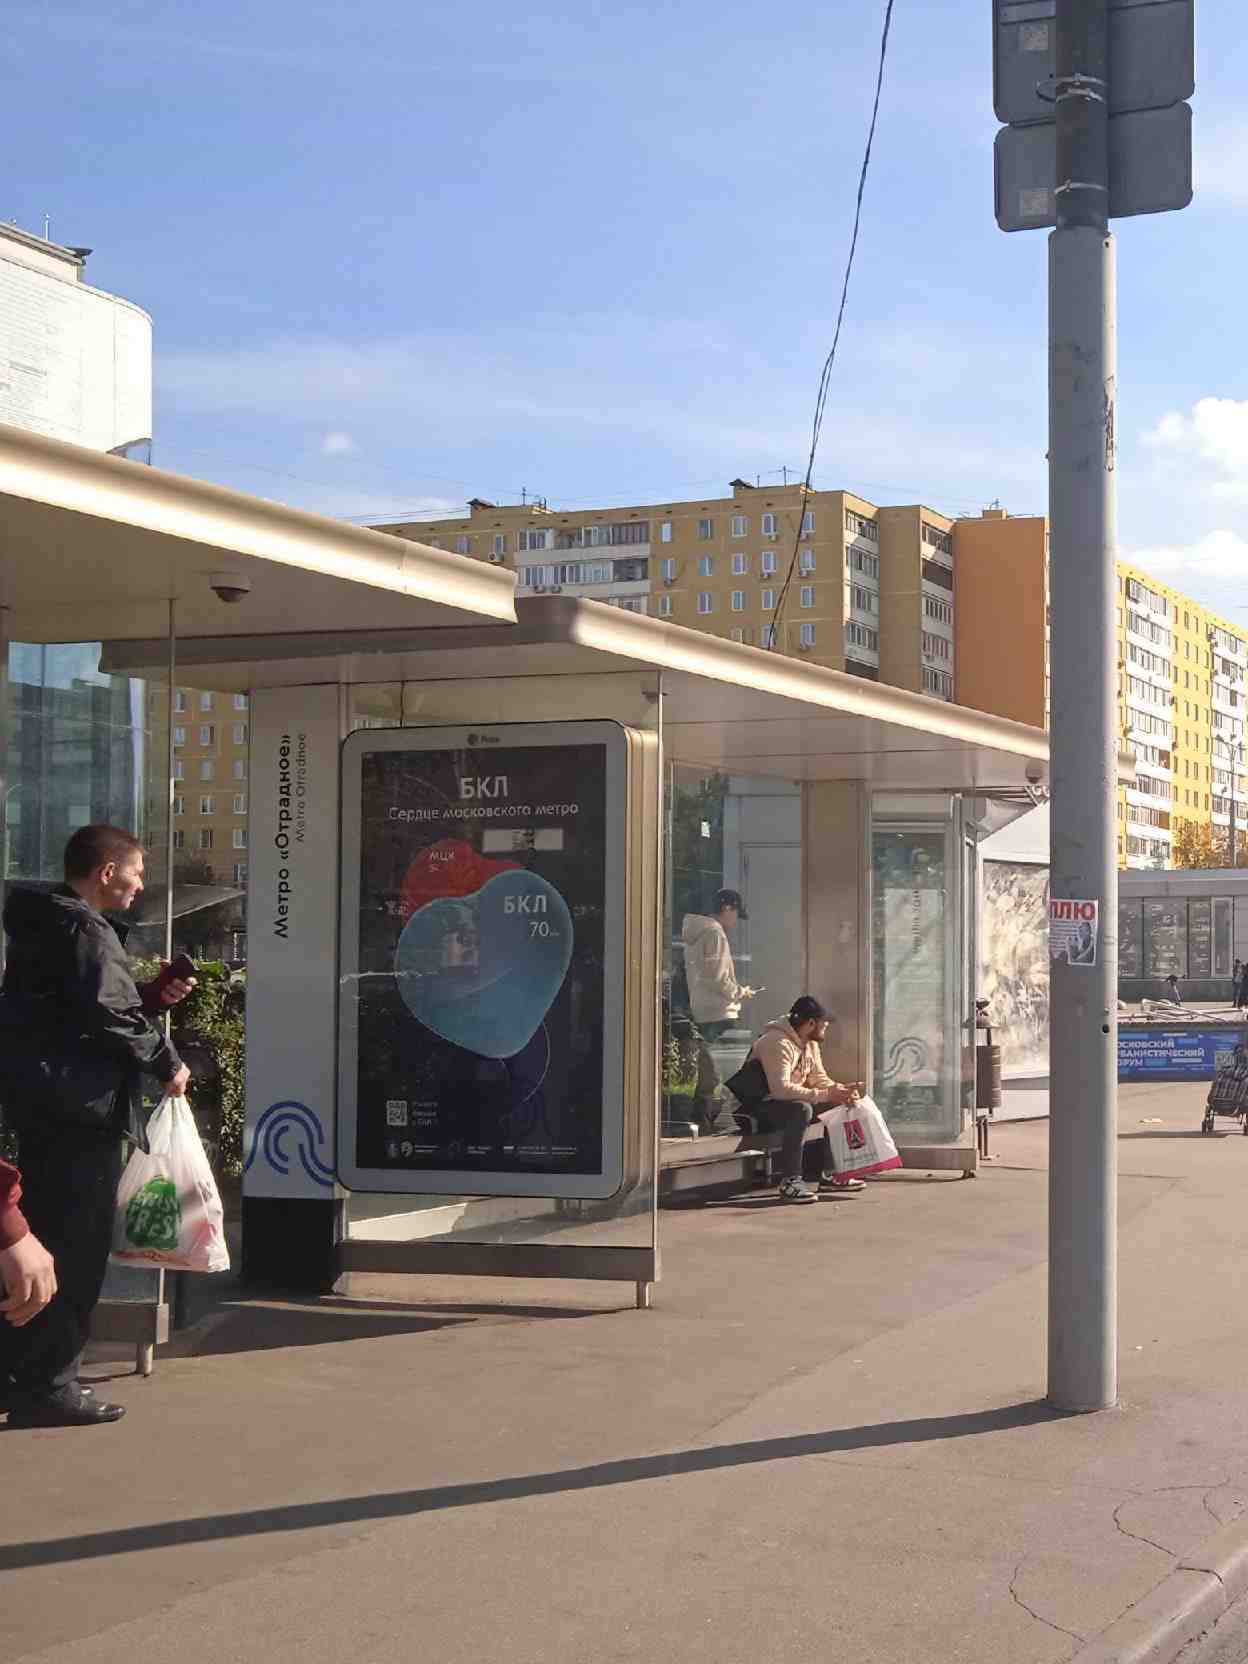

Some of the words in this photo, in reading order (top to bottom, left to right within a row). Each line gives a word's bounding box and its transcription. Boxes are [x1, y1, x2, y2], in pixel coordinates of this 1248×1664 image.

[275, 734, 292, 860] «Отрадное»
[460, 776, 509, 799] БКЛ
[295, 801, 305, 843] Metro
[388, 807, 440, 823] Сердце
[443, 804, 532, 819] московского
[535, 802, 579, 817] метро
[273, 868, 292, 938] Метро
[503, 894, 547, 914] БКЛ
[529, 921, 549, 937] 70
